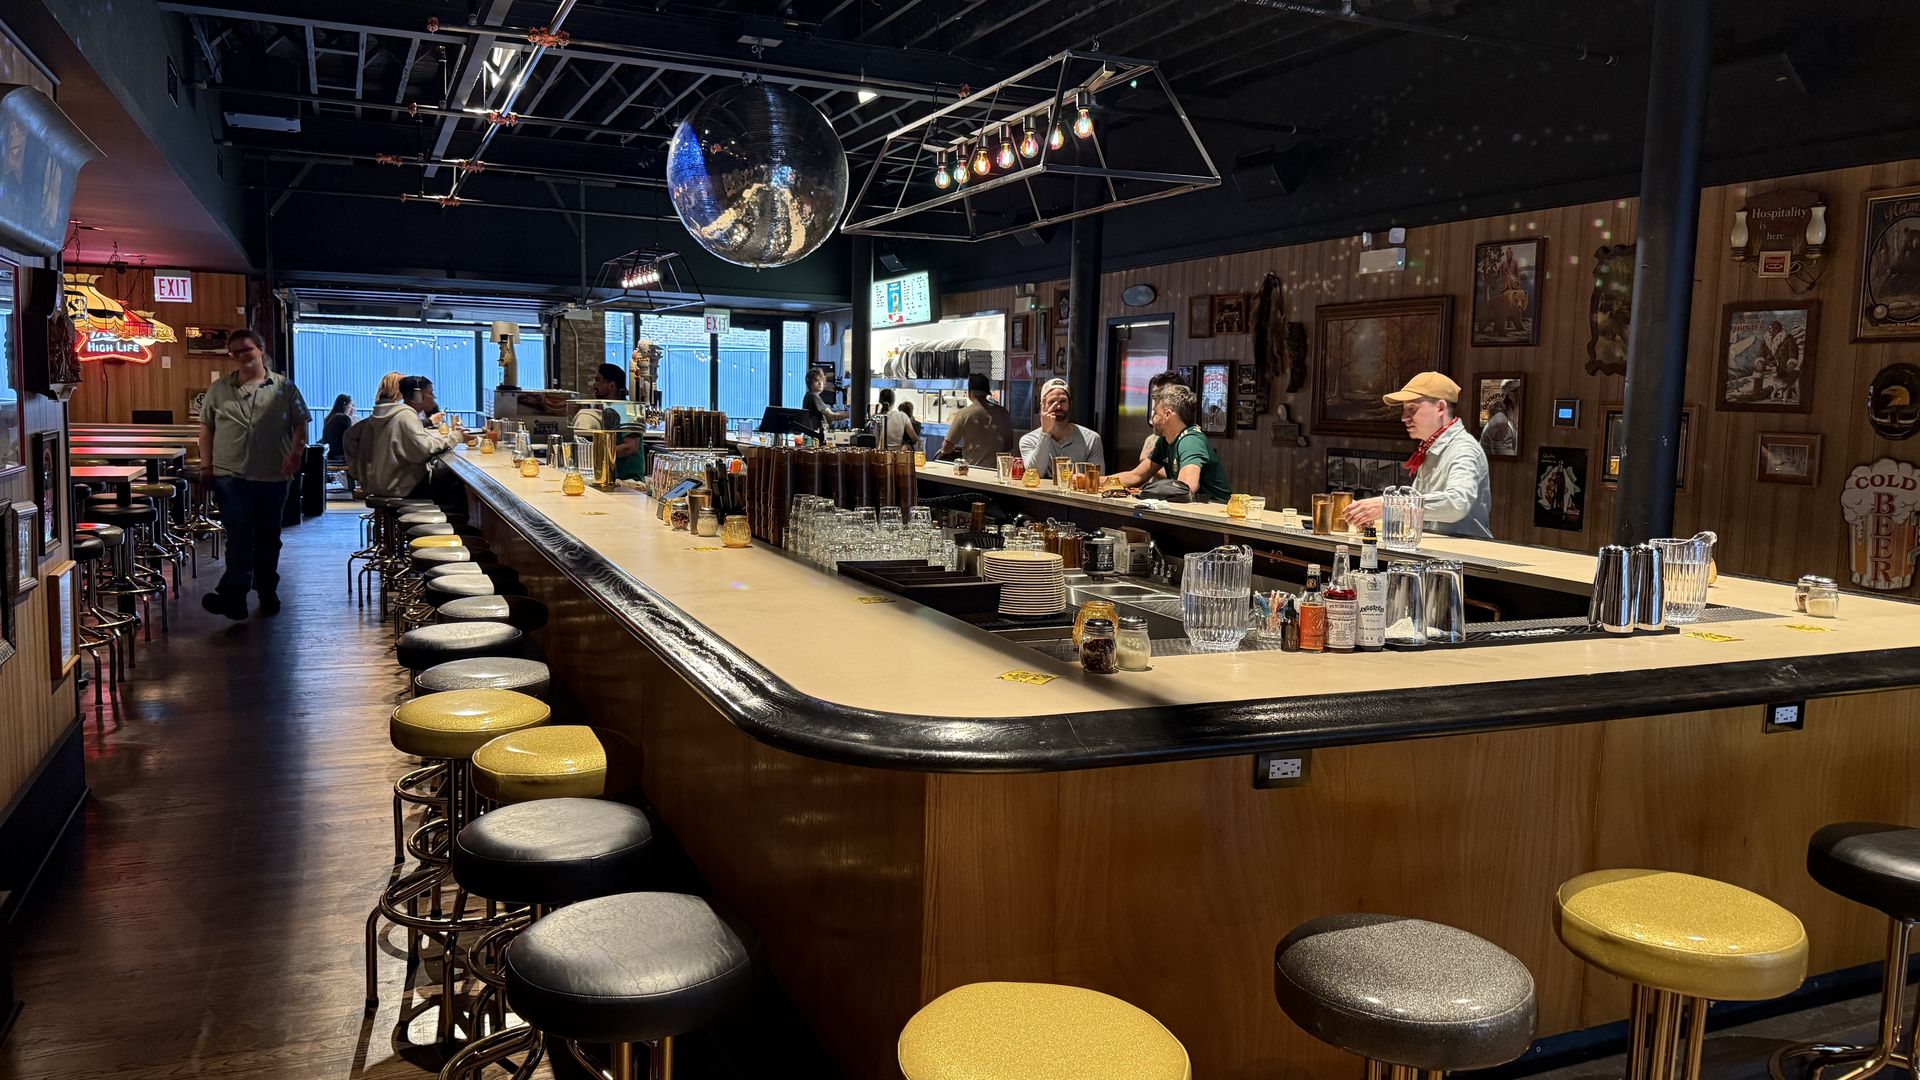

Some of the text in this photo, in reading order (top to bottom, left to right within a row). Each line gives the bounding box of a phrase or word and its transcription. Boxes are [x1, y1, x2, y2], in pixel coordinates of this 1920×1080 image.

[1751, 206, 1808, 220] Hospitality
[1759, 222, 1768, 230] is
[1766, 232, 1785, 241] here
[158, 278, 188, 297] EXIT
[706, 316, 727, 331] EXIT
[87, 341, 140, 353] HIGH LIFE
[1855, 474, 1917, 491] COLD
[1871, 492, 1895, 583] BEER
